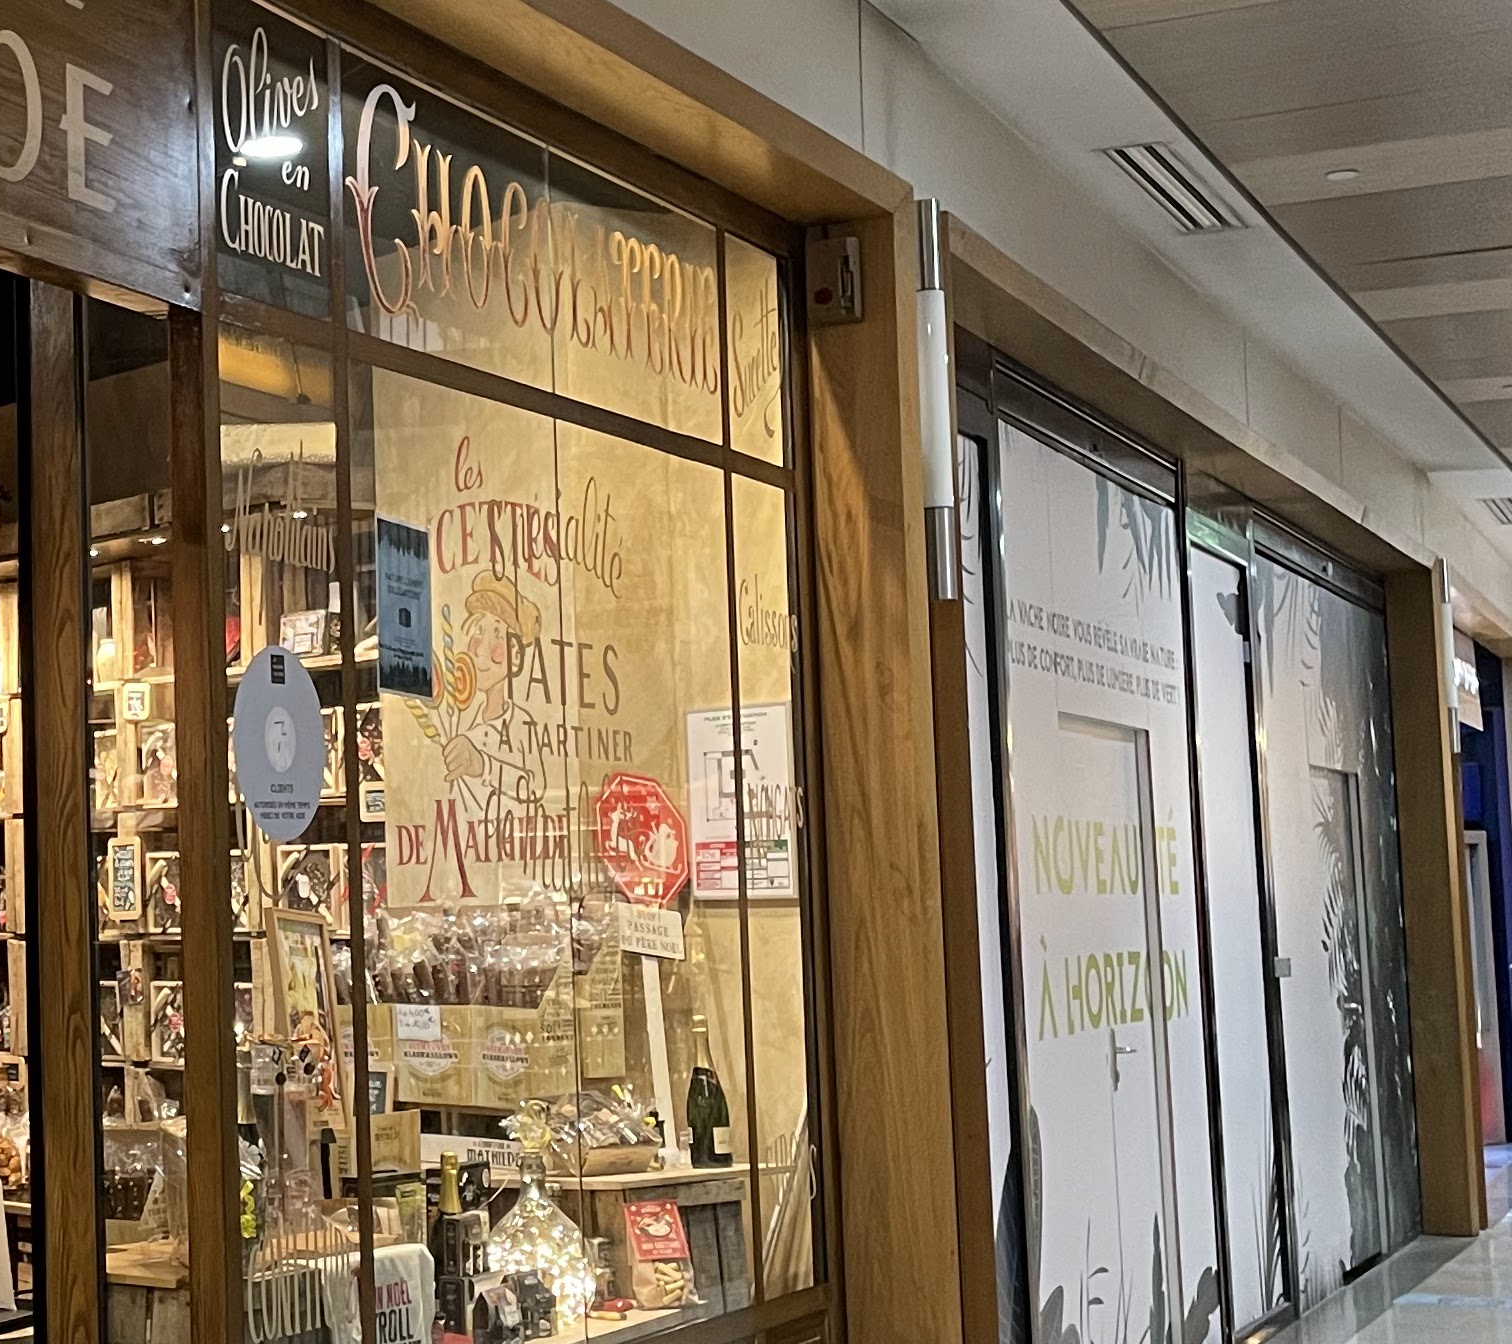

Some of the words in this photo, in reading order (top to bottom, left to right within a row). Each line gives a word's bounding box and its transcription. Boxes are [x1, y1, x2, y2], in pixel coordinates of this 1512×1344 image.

[222, 27, 318, 152] Olives
[282, 161, 310, 191] en
[220, 168, 325, 278] CHOCOLAT
[345, 83, 719, 396] CHOCOLATERIE
[454, 436, 484, 492] les
[435, 499, 560, 587] CETTES
[1018, 601, 1045, 631] VACHE
[1046, 609, 1070, 639] NOIRE
[1072, 618, 1093, 646] VOUS
[1027, 644, 1038, 669] DE
[1077, 657, 1094, 684] PLUS
[1095, 663, 1105, 687] DE
[523, 721, 634, 763] TARTINER
[396, 824, 428, 867] DE
[627, 920, 670, 938] PASSAGE
[1064, 949, 1190, 1036] HORIZON
[387, 1277, 413, 1308] NOËL
